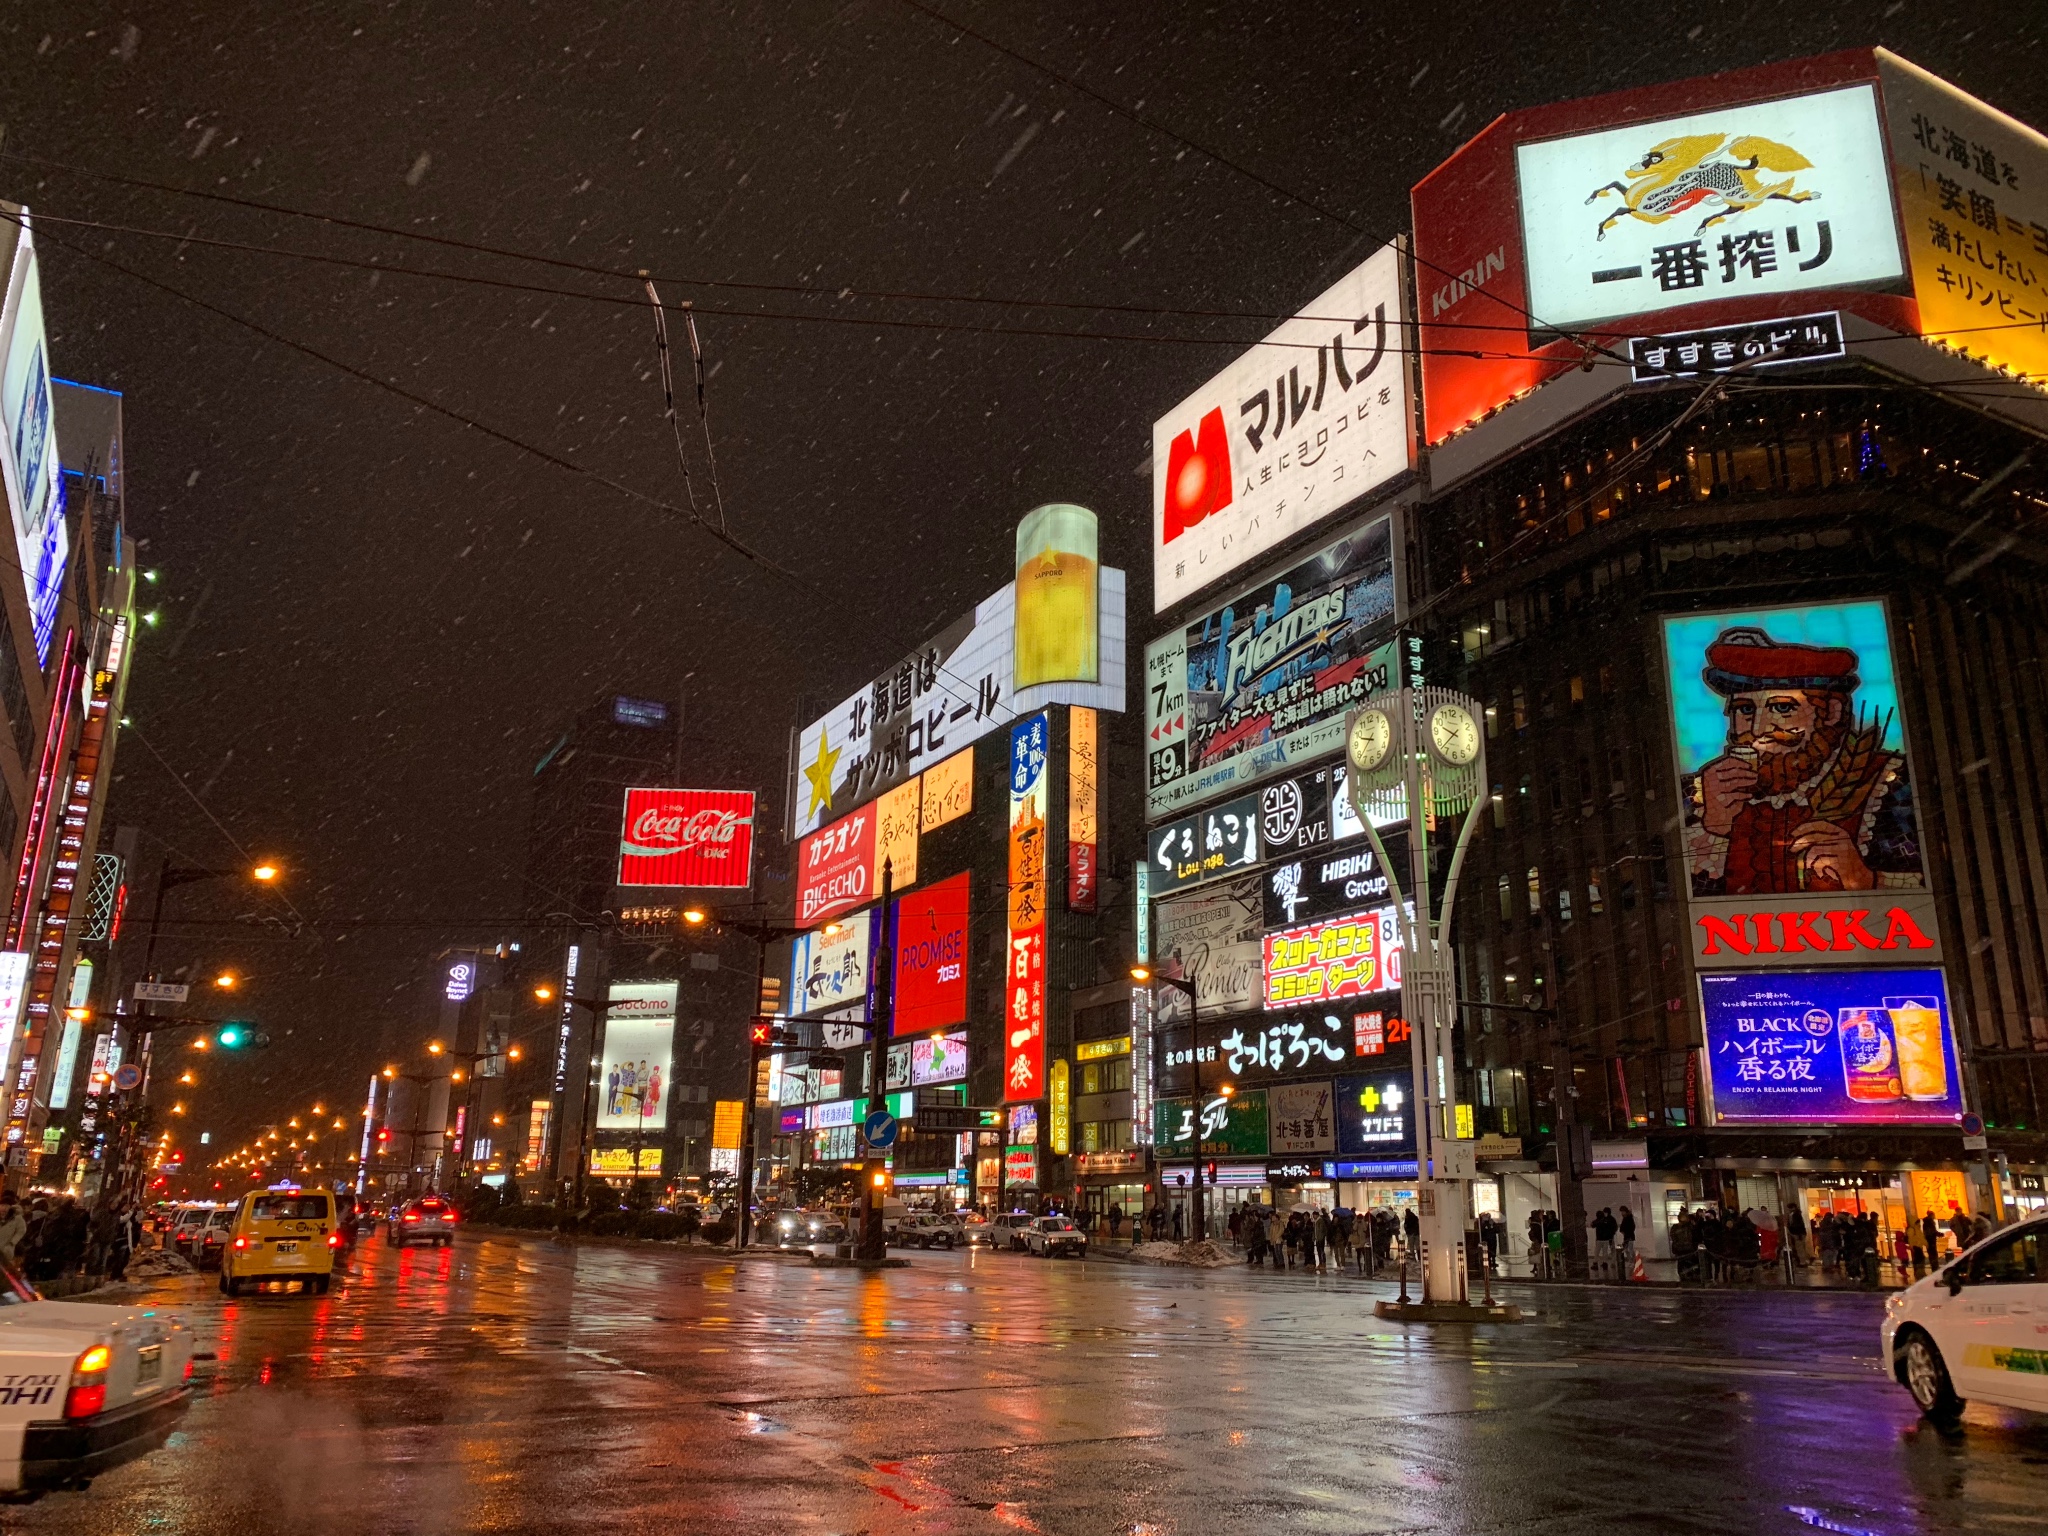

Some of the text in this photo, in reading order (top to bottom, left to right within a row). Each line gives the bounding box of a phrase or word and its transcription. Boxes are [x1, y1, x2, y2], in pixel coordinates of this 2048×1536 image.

[1911, 113, 2019, 190] 北海道を
[1592, 220, 1836, 292] 一番搾り
[1430, 246, 1506, 317] KIRIN
[1643, 326, 1829, 369] すすきのビル
[1240, 302, 1388, 454] マルハン
[1242, 386, 1392, 497] 人生にヨロコビを
[1175, 449, 1378, 580] 新しいパチンコへ
[1034, 569, 1063, 580] SAPPORO
[1149, 644, 1184, 672] 札幌ドーム
[1219, 585, 1348, 711] FIGHTERS
[1160, 663, 1174, 678] まで
[849, 648, 937, 743] 北海道は
[1151, 681, 1184, 718] 7km
[1197, 676, 1315, 742] ファイターズを見ずに
[1435, 717, 1444, 726] 10
[1440, 710, 1448, 719] 11
[1448, 709, 1457, 718] 12
[1459, 714, 1464, 722] 1
[1465, 722, 1471, 731] 2
[847, 673, 1001, 799] サッポロビール
[1289, 735, 1310, 753] または
[1434, 727, 1439, 735] 9
[1437, 737, 1443, 747] 8
[1468, 733, 1474, 742] 3
[1444, 746, 1450, 755] 7
[1452, 751, 1458, 760] 6
[1460, 749, 1466, 758] 5
[1466, 743, 1471, 752] 4
[1015, 735, 1028, 790] 革命
[633, 808, 739, 843] Coca-Cola
[1297, 821, 1329, 847] EVE
[697, 845, 730, 859] Coke
[808, 815, 866, 869] カラオケ
[1157, 813, 1241, 871] くろねこ
[809, 867, 827, 884] Karaoke
[827, 853, 860, 876] Entertainment
[1016, 827, 1039, 925] 百姓一揆
[1076, 844, 1090, 900] カラオケ
[1177, 853, 1225, 880] Lounge
[1321, 852, 1373, 883] HIBIKI
[803, 881, 828, 920] BIG
[828, 864, 866, 900] ECHO
[1345, 875, 1388, 899] Group
[1697, 906, 1935, 956] NIKKA
[901, 929, 962, 975] PROMISE
[1269, 923, 1374, 972] ネットカフェ
[805, 947, 861, 999] 長次郎
[937, 962, 961, 984] プロミス
[1031, 933, 1041, 1036] 本格 麦焼酎
[1270, 959, 1375, 1002] コミック ダーツ
[140, 984, 184, 994] すすきの
[64, 998, 82, 1055] 東イン
[1010, 937, 1033, 1091] 百姓一揆
[1355, 1014, 1382, 1031] 炭火焼き
[1737, 1018, 1802, 1033] BLACK
[1808, 1015, 1829, 1024] 北海道
[1089, 1040, 1126, 1056] すすきの交番
[1220, 1016, 1346, 1075] さっぽろっこ
[1719, 1037, 1826, 1055] ハイボール
[912, 1070, 921, 1083] 1F
[1736, 1055, 1816, 1081] 香る夜
[1056, 1079, 1067, 1151] すすきの交番
[1276, 1117, 1329, 1139] 北海番屋
[1362, 1117, 1404, 1133] サツドラ
[604, 1152, 659, 1162] やきとりンター
[1360, 1165, 1383, 1174] HOKKAIDO
[1383, 1164, 1398, 1173] HAPPY
[1932, 1175, 1947, 1214] タイムズ
[1943, 1176, 1959, 1199] 札幌
